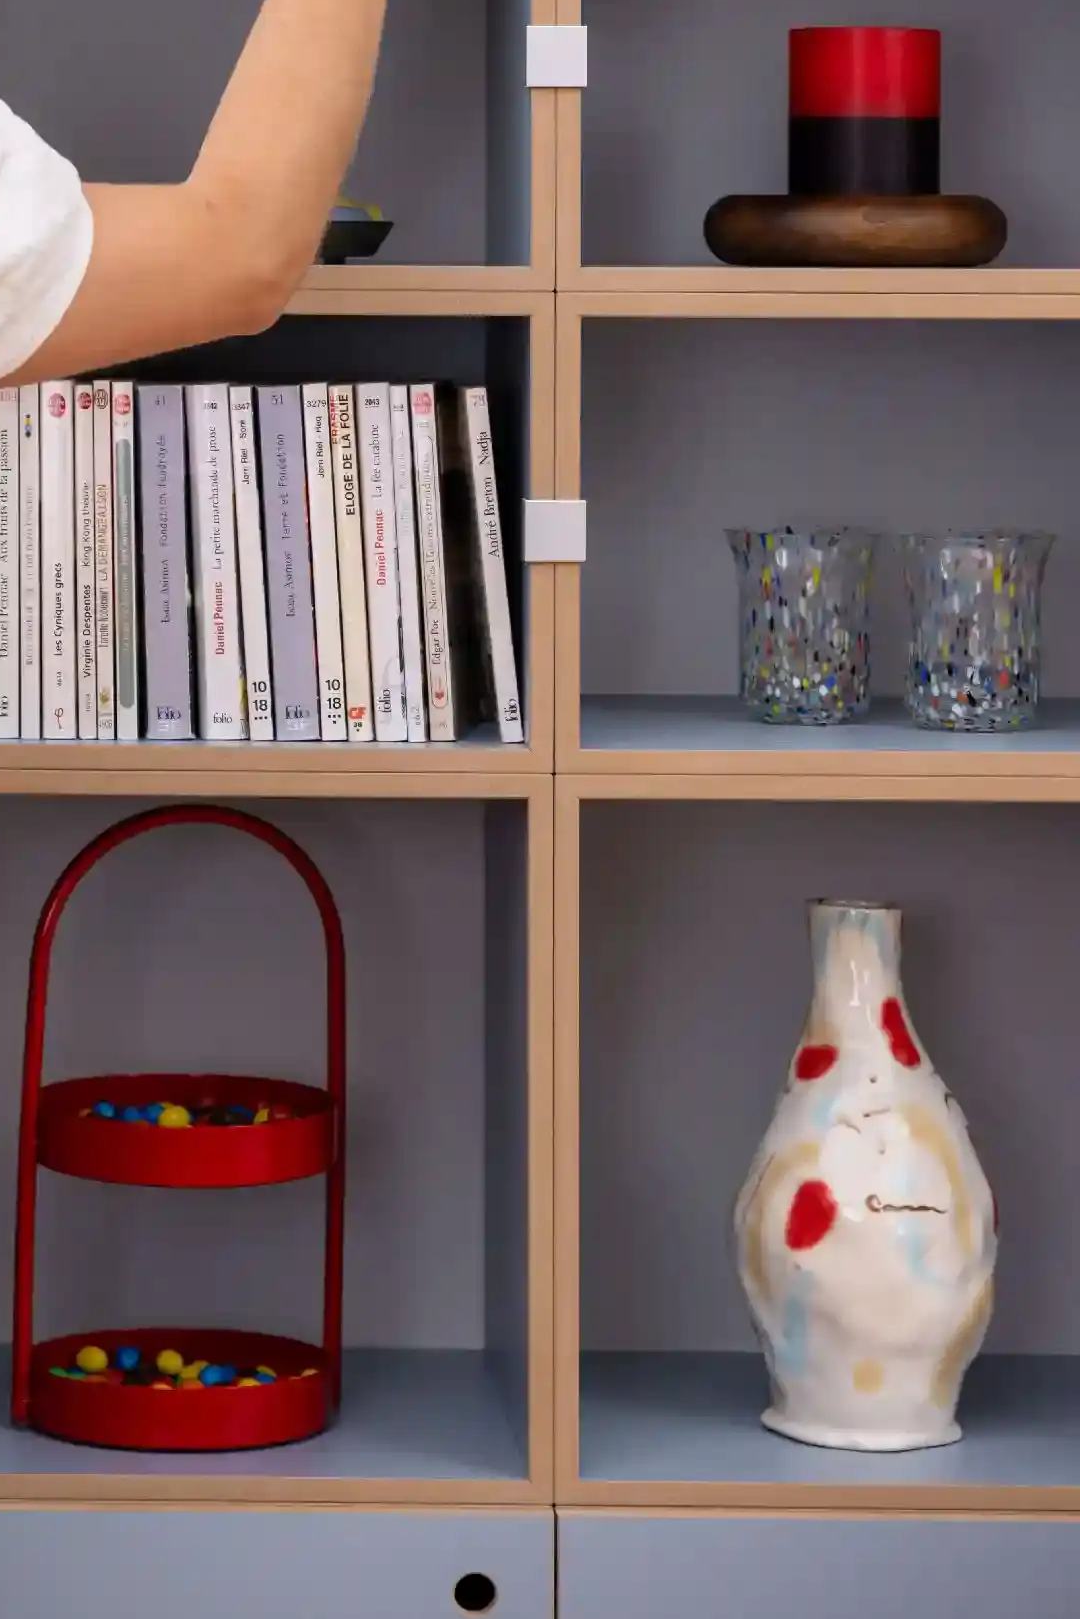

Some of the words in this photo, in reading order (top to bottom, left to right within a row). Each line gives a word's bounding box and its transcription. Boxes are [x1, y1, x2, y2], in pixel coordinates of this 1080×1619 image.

[306, 399, 326, 408] 3279
[338, 393, 350, 430] FOLIE
[206, 427, 220, 453] prose
[315, 441, 325, 457] Riel
[341, 433, 352, 449] LA
[477, 431, 493, 465] Nadja
[207, 456, 218, 467] de
[240, 448, 250, 464] Riel
[341, 453, 352, 470] DE
[371, 468, 382, 483] fée
[207, 469, 222, 524] marchande
[343, 474, 356, 516] ELOGE
[372, 486, 383, 498] La
[482, 476, 495, 516] Breton
[82, 518, 92, 543] Kong
[209, 526, 224, 555] petite
[374, 510, 386, 549] Pennac
[485, 519, 501, 558] André
[82, 546, 92, 568] King
[211, 557, 223, 570] La
[374, 552, 387, 586] Daniel
[54, 563, 64, 589] grecs
[82, 584, 93, 636] Despentes
[212, 581, 223, 620] Pennac
[53, 591, 64, 638] Cyniques
[54, 640, 63, 657] Les
[213, 621, 225, 656] Daniel
[82, 639, 93, 678] Virginie
[431, 639, 445, 665] Edgar
[252, 681, 267, 693] 10
[325, 679, 340, 691] 10
[252, 699, 268, 711] 18
[327, 698, 342, 710] 18
[379, 688, 391, 713] folio
[505, 698, 519, 721] folio
[213, 712, 233, 724] folio
